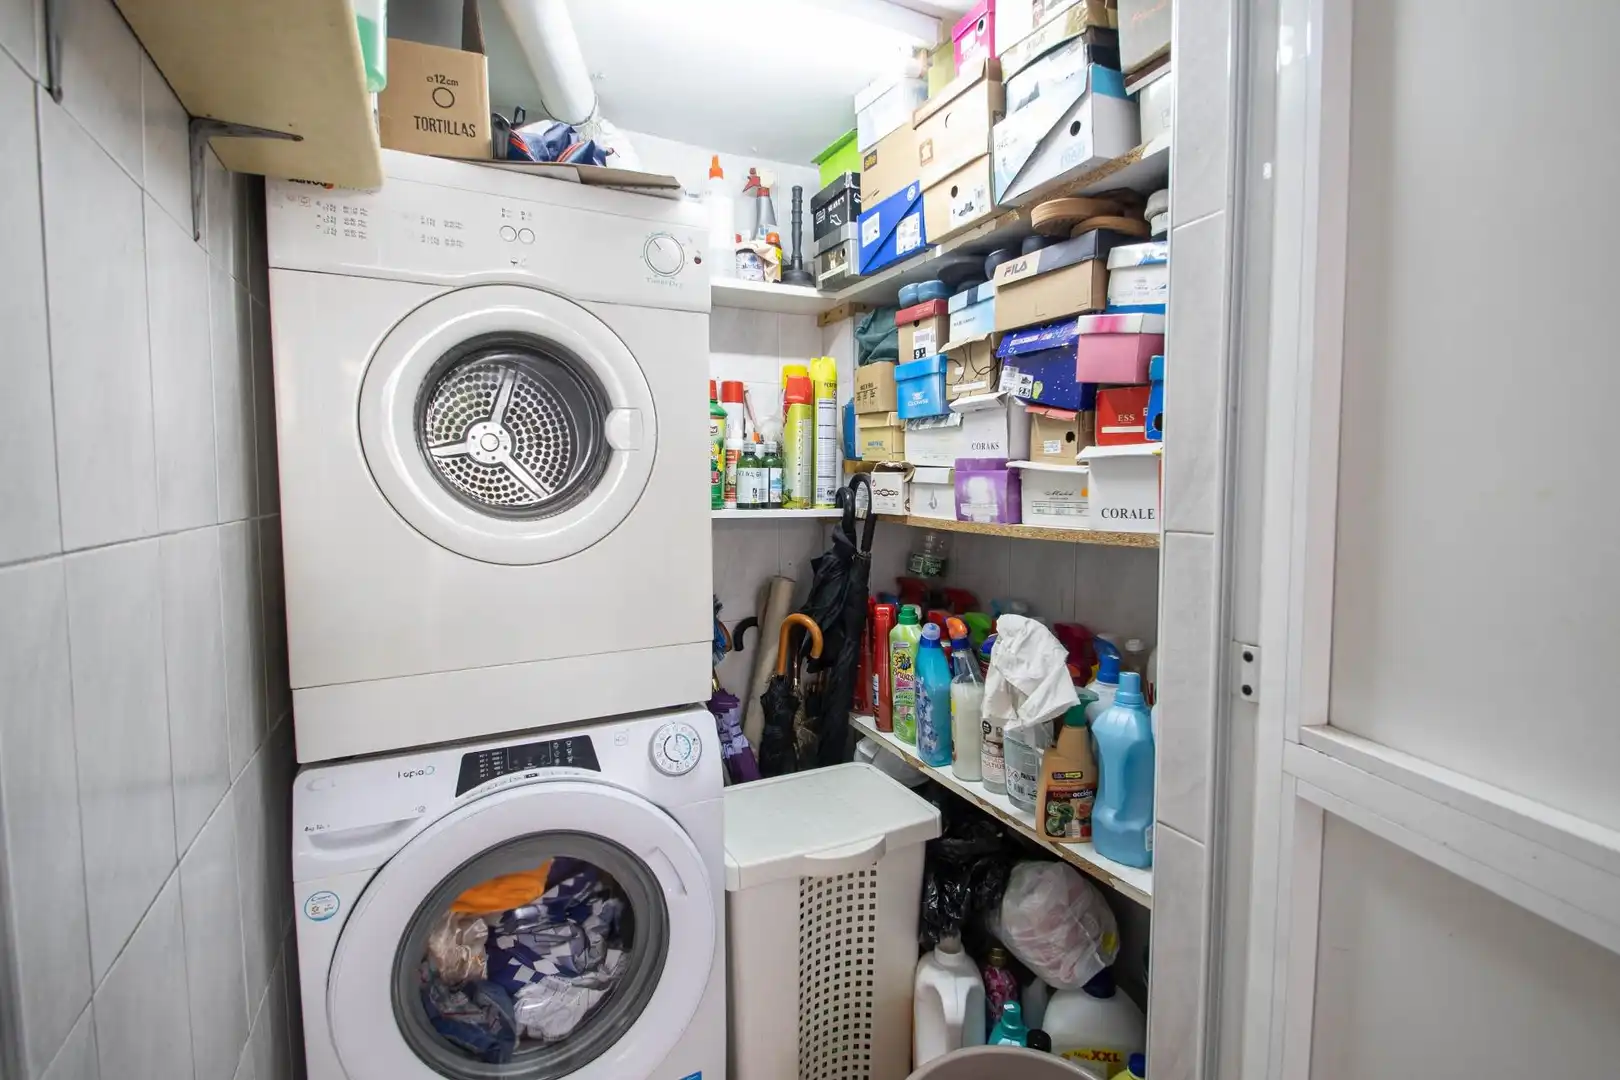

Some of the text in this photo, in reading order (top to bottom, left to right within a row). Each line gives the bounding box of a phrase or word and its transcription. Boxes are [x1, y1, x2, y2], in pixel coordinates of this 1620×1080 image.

[413, 115, 476, 138] TORTILLAS
[1004, 260, 1028, 278] FILA
[1117, 413, 1136, 422] ESS
[971, 441, 1000, 451] CORAKS
[1101, 507, 1156, 521] CORALE
[1072, 789, 1093, 798] acción
[1091, 1050, 1120, 1062] XXL
